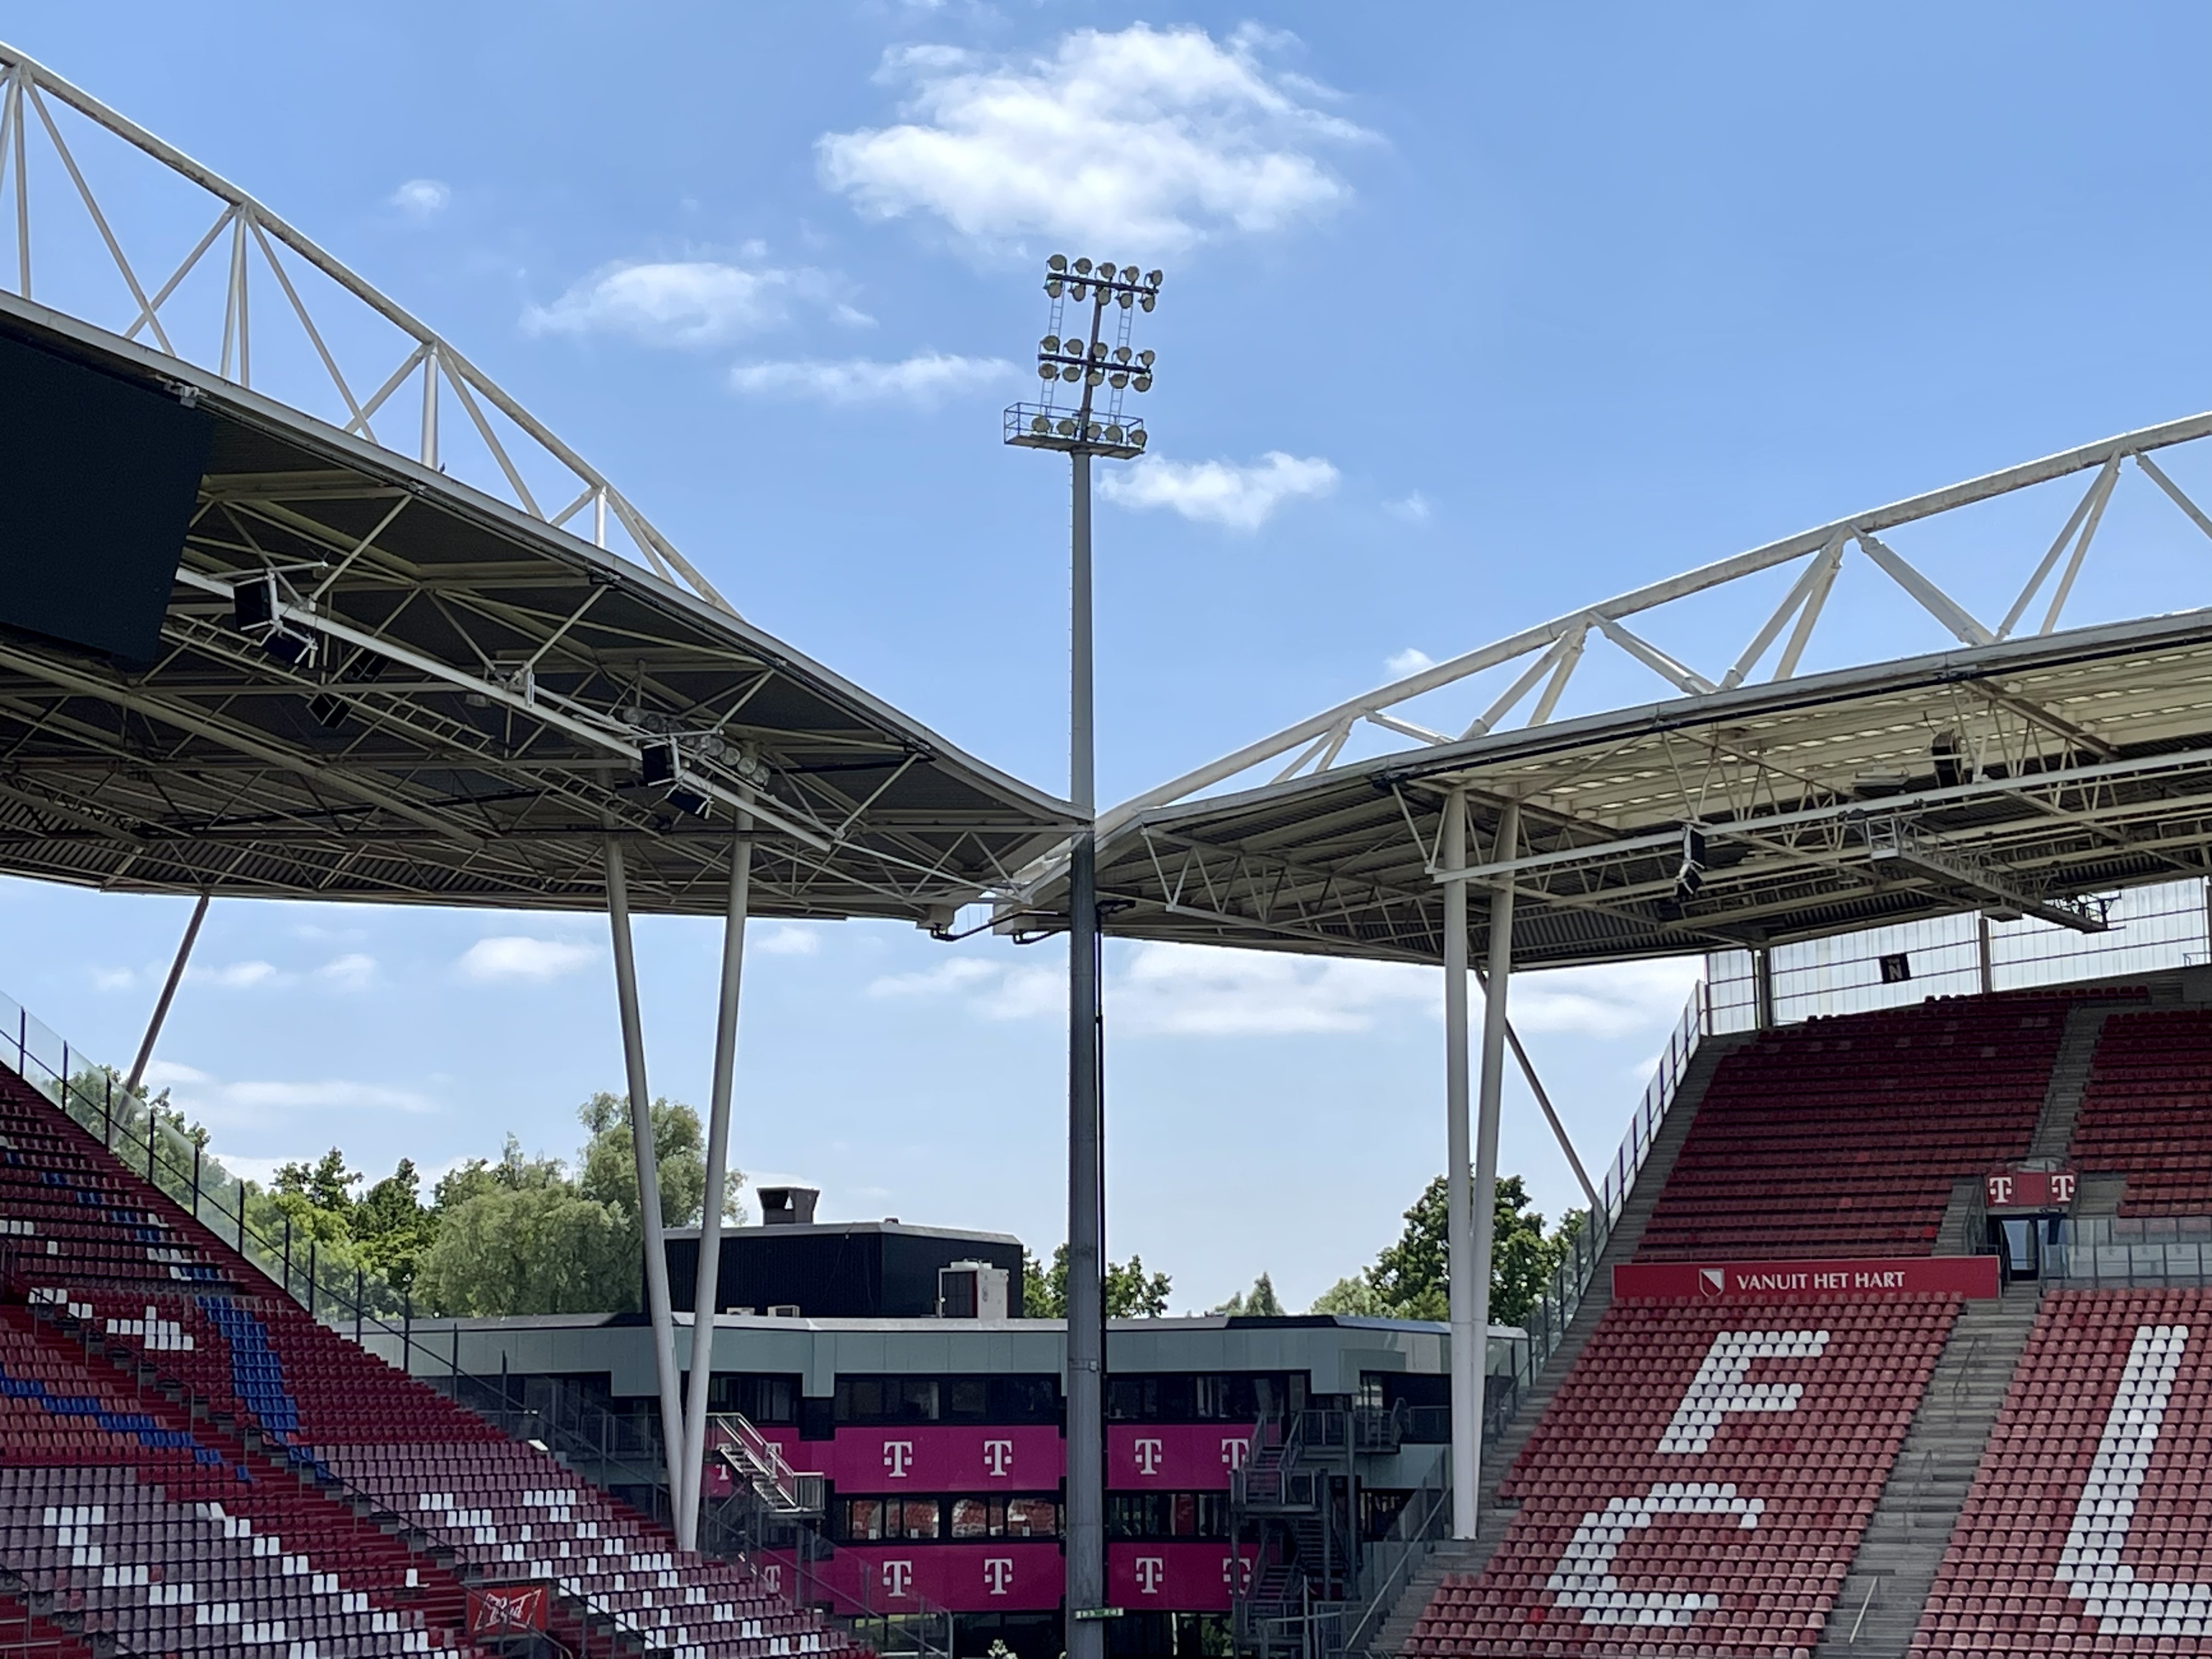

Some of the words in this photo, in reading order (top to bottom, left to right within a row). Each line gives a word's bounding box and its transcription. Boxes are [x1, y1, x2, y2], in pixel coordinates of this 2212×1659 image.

[1989, 1177, 2012, 1203] T
[2051, 1175, 2075, 1201] T
[1736, 1273, 1809, 1290] VANUIT
[1814, 1272, 1849, 1289] HET
[1854, 1271, 1905, 1288] HART
[884, 1441, 912, 1477] T
[984, 1440, 1012, 1476] T
[1135, 1439, 1162, 1475] T
[883, 1560, 912, 1596] T
[984, 1559, 1013, 1594] T
[1136, 1558, 1163, 1594] T
